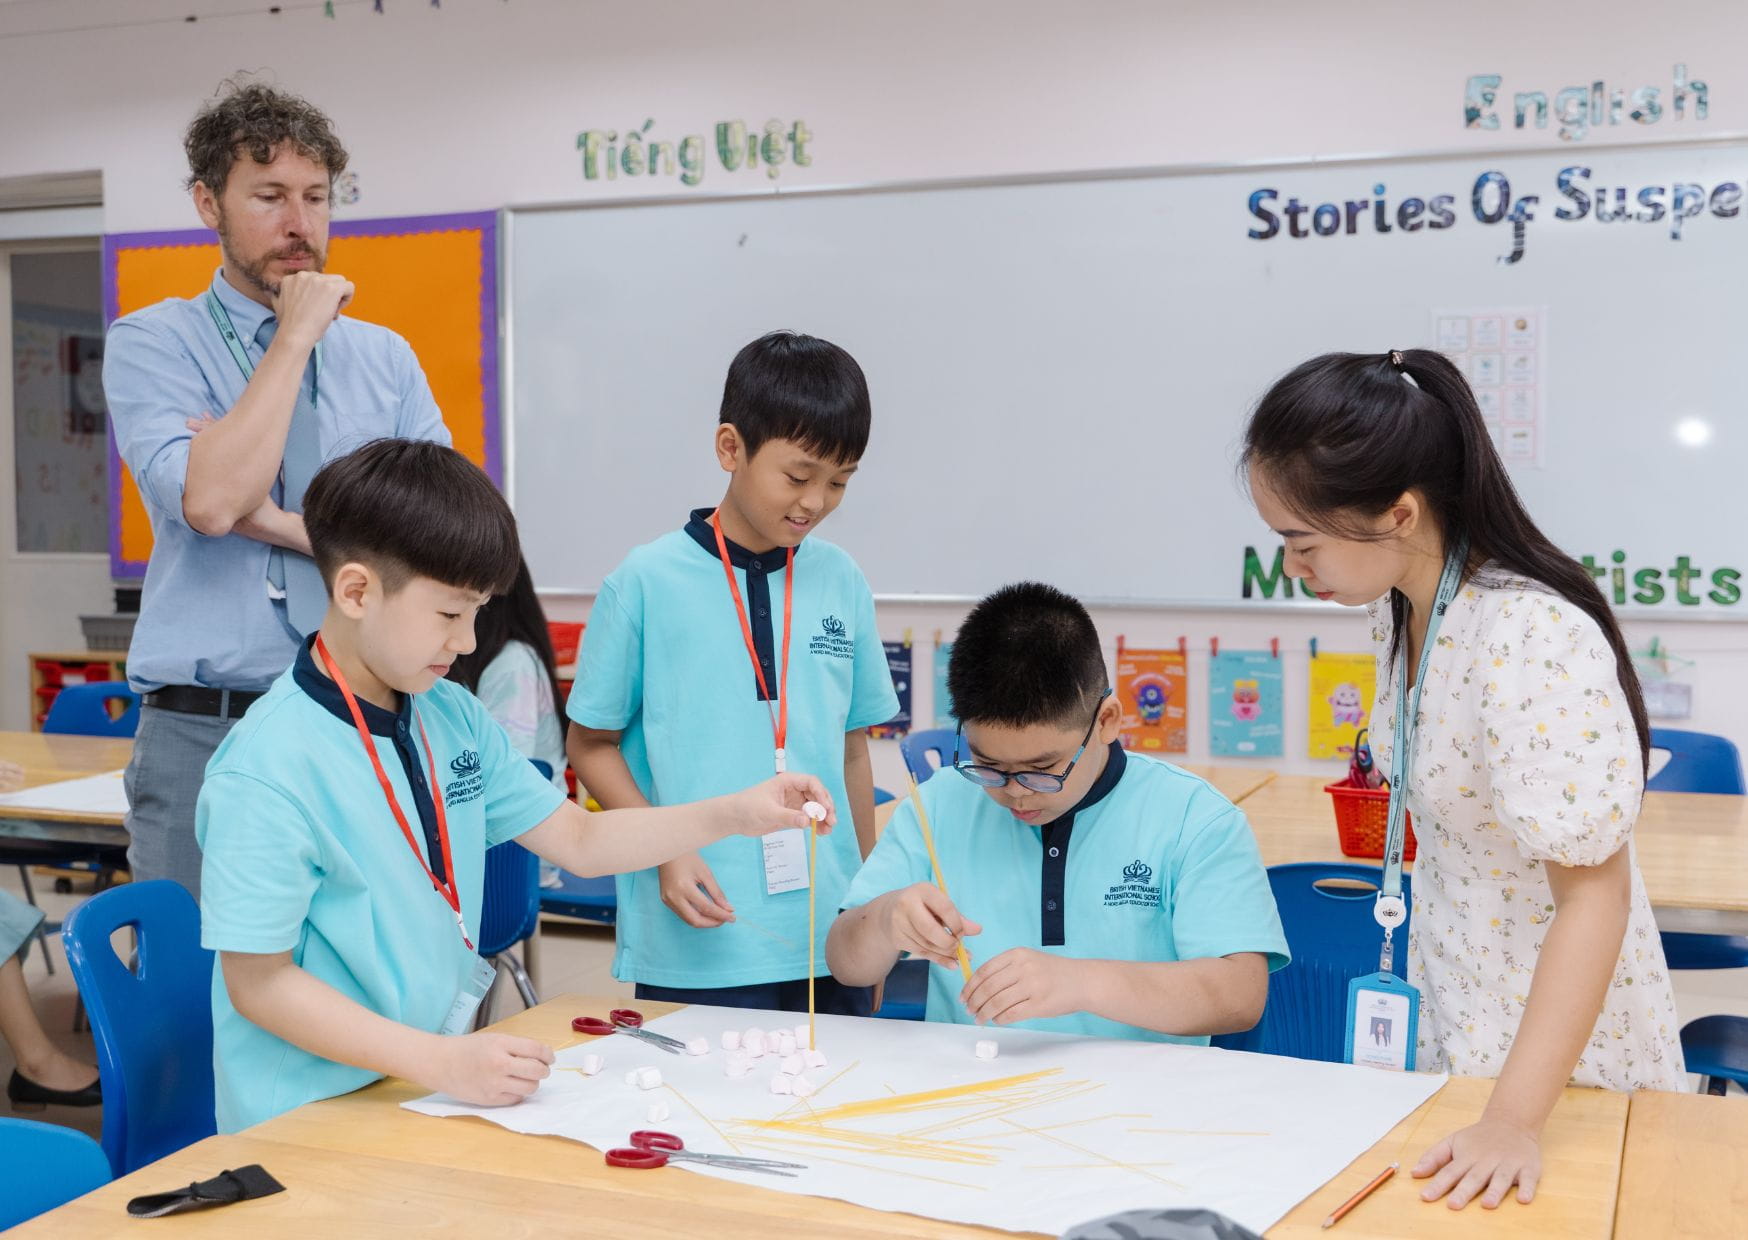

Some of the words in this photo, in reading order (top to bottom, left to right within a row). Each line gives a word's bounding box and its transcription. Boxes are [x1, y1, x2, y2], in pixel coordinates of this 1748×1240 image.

[1464, 63, 1709, 141] English
[576, 118, 705, 186] Tiếng
[715, 117, 813, 180] Việt
[1247, 183, 1457, 240] Stories
[1471, 170, 1540, 265] Of
[1554, 165, 1748, 241] Suspe
[1242, 545, 1316, 600] M
